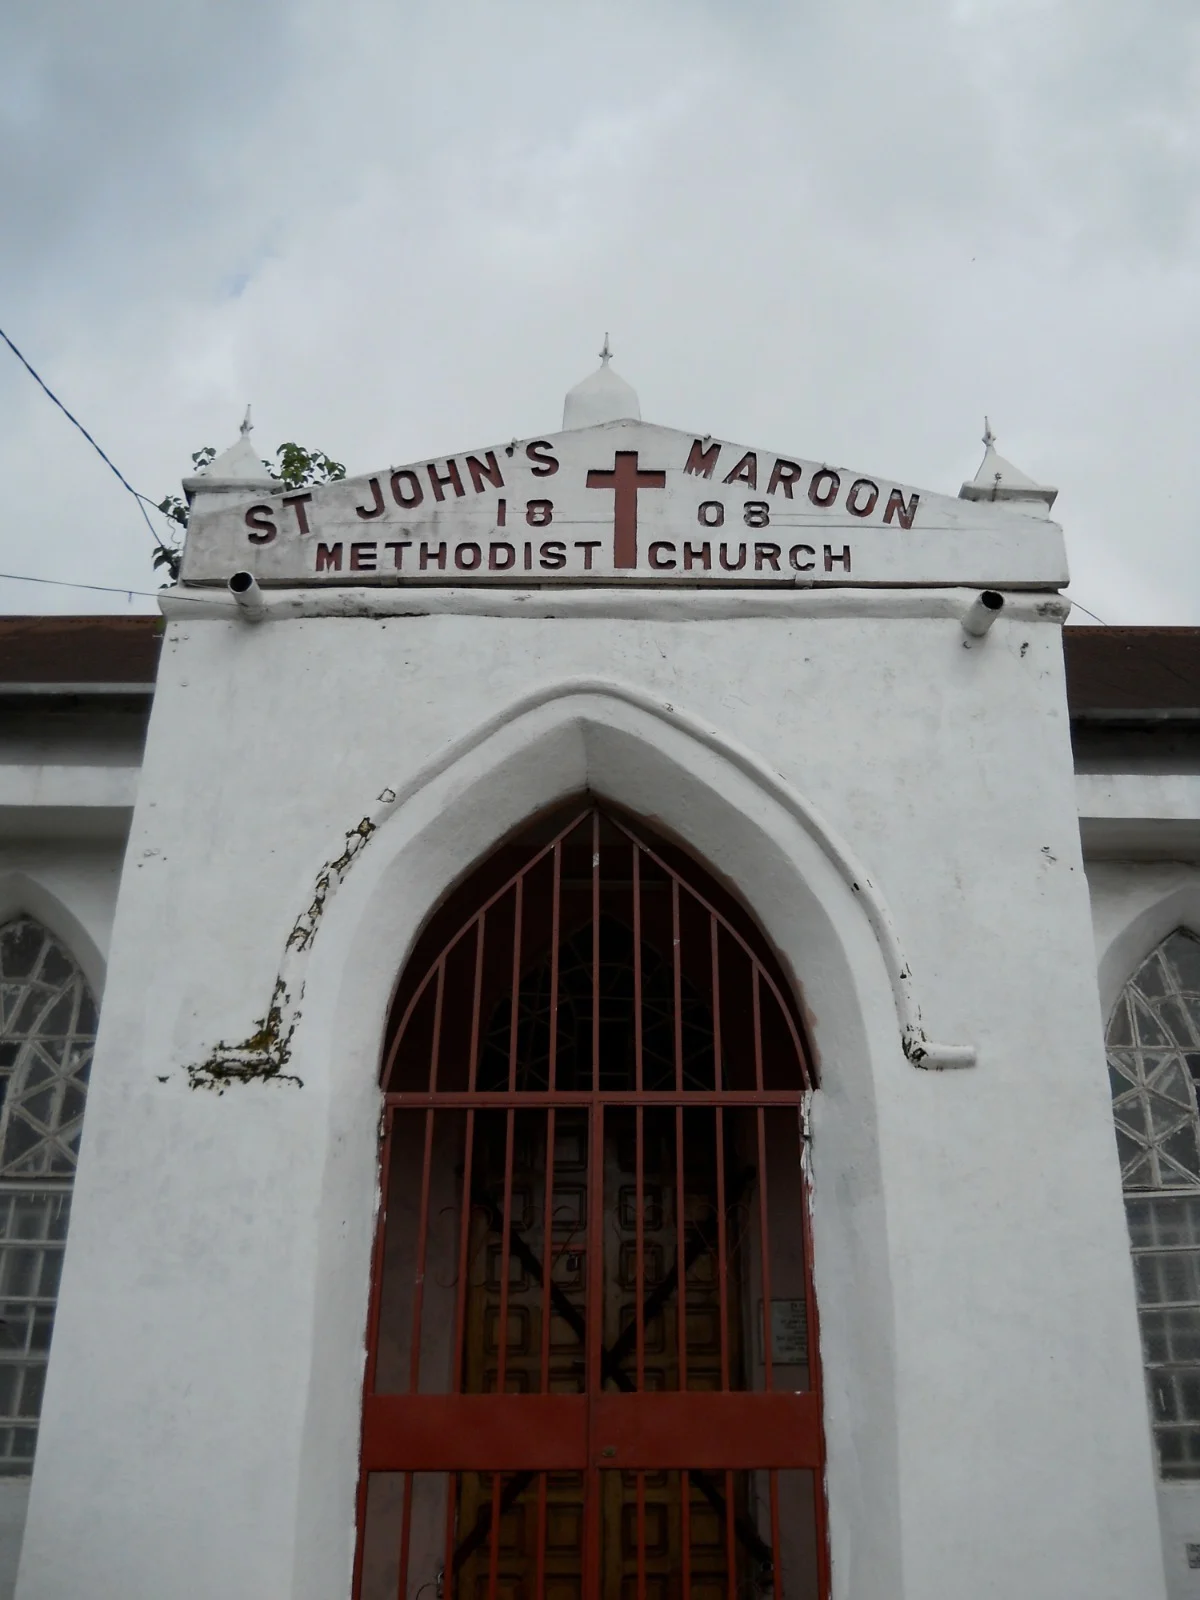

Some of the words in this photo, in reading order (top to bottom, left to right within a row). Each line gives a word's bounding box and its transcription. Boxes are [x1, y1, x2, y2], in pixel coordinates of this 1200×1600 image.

[244, 493, 313, 545] ST
[355, 440, 560, 520] JOHN'S
[683, 438, 920, 530] MAROON
[497, 498, 554, 527] 18
[698, 500, 771, 528] 08
[315, 540, 602, 573] METHODIST
[648, 541, 852, 573] CHURCH
